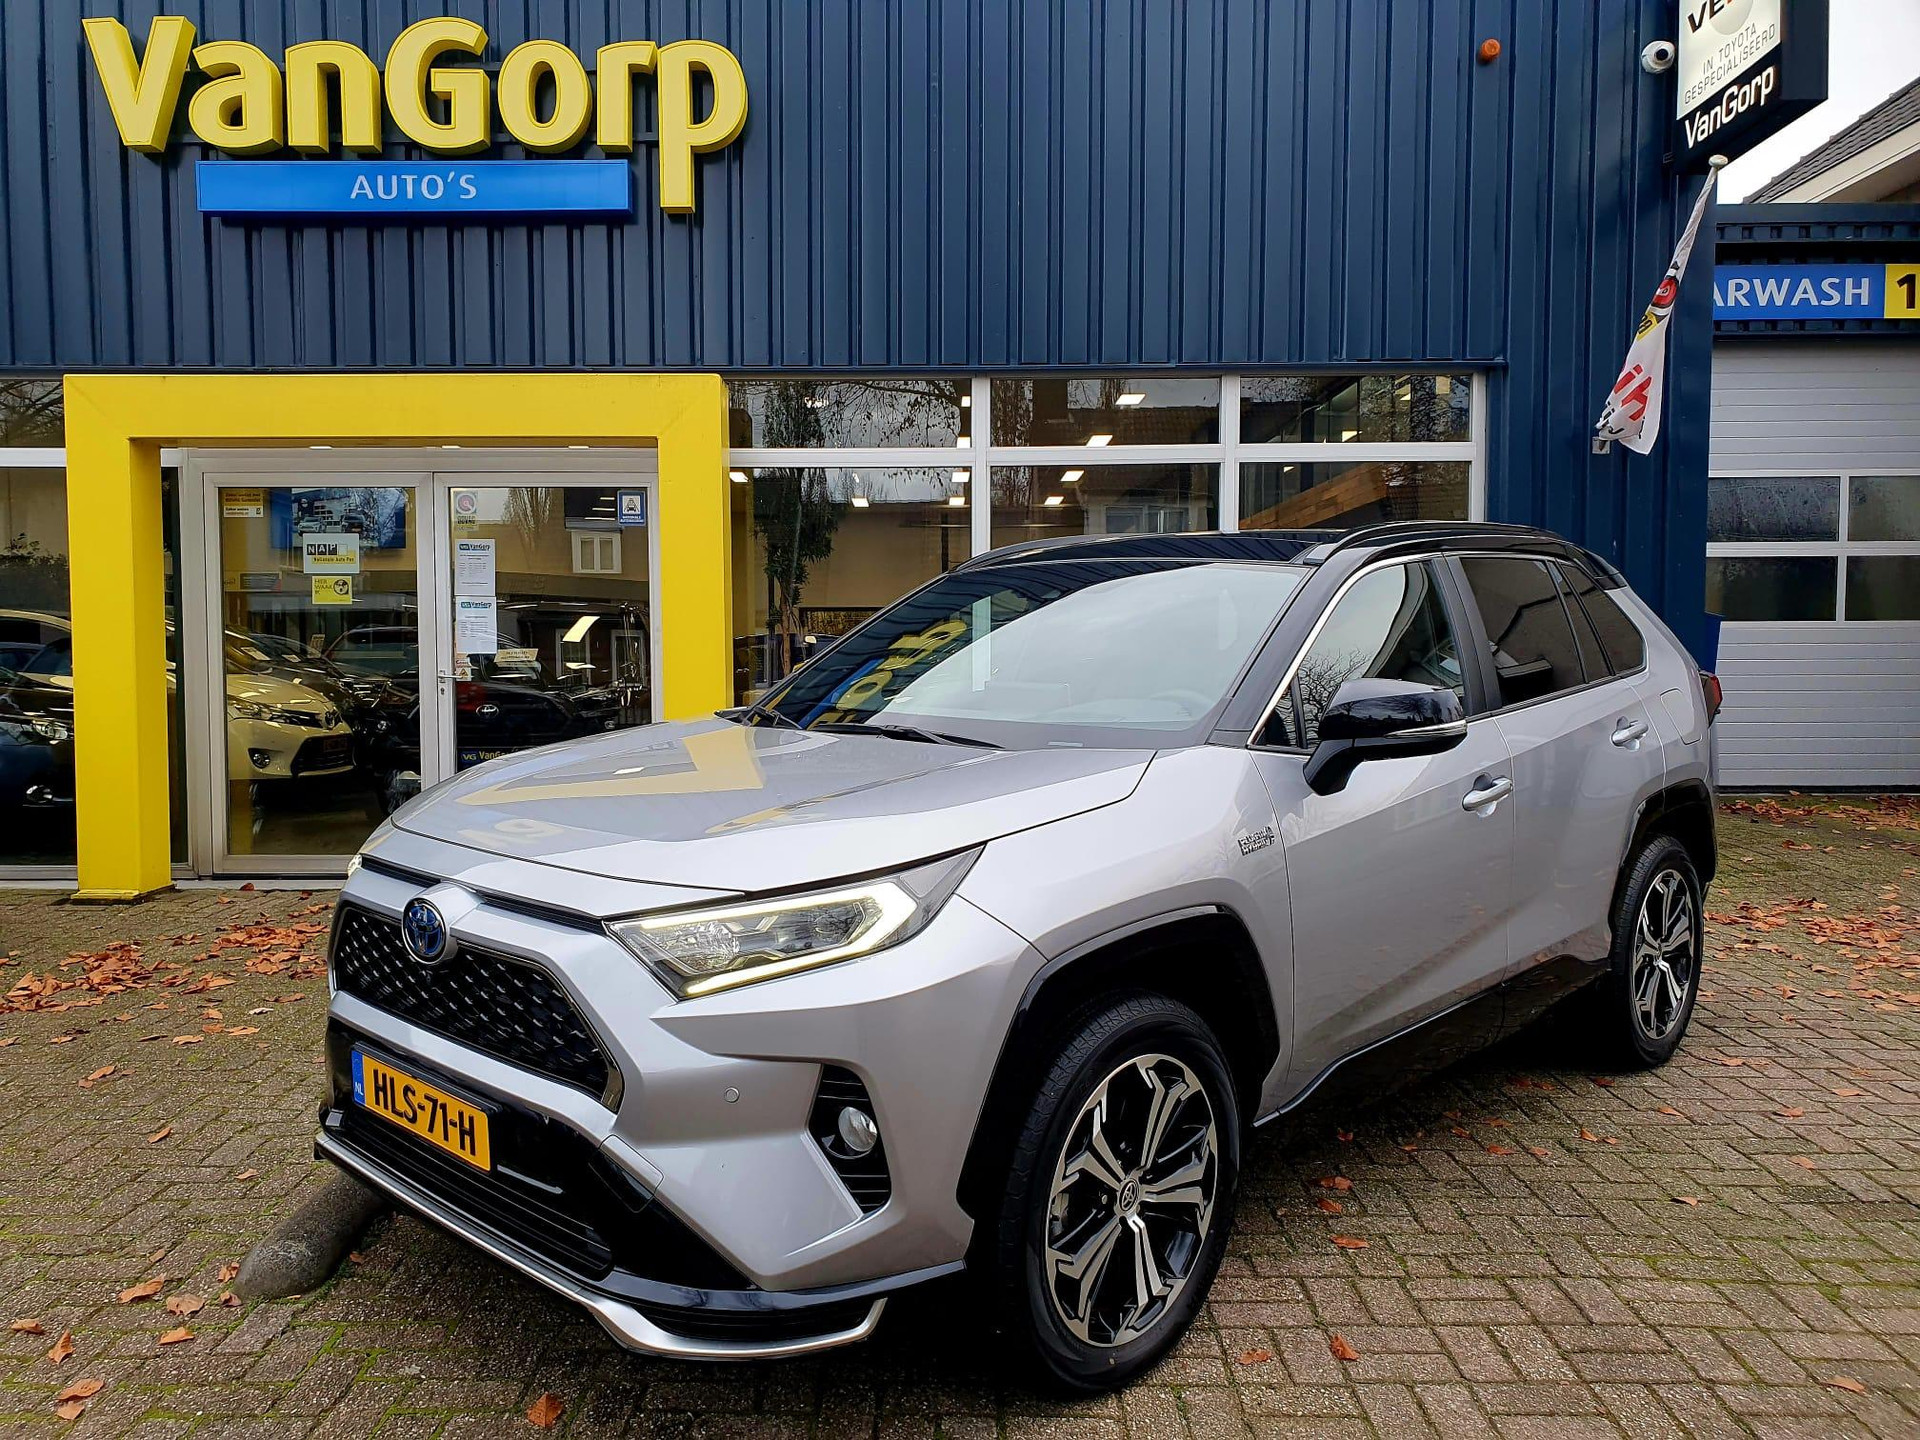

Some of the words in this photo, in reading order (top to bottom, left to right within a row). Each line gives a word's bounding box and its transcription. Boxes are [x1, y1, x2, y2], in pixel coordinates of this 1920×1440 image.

[1687, 0, 1733, 34] VE
[1684, 23, 1776, 105] GESPECIALISEERD
[1703, 57, 1714, 75] IN
[1719, 22, 1757, 61] TOYOTA
[82, 16, 749, 214] VanGorp
[1684, 65, 1775, 149] VanGorp
[350, 170, 477, 200] AUTO'S
[1896, 273, 1917, 309] 1
[307, 544, 337, 555] NAP
[479, 750, 505, 760] VanG
[354, 1081, 364, 1096] NL
[373, 1068, 476, 1157] HLS-71-H
